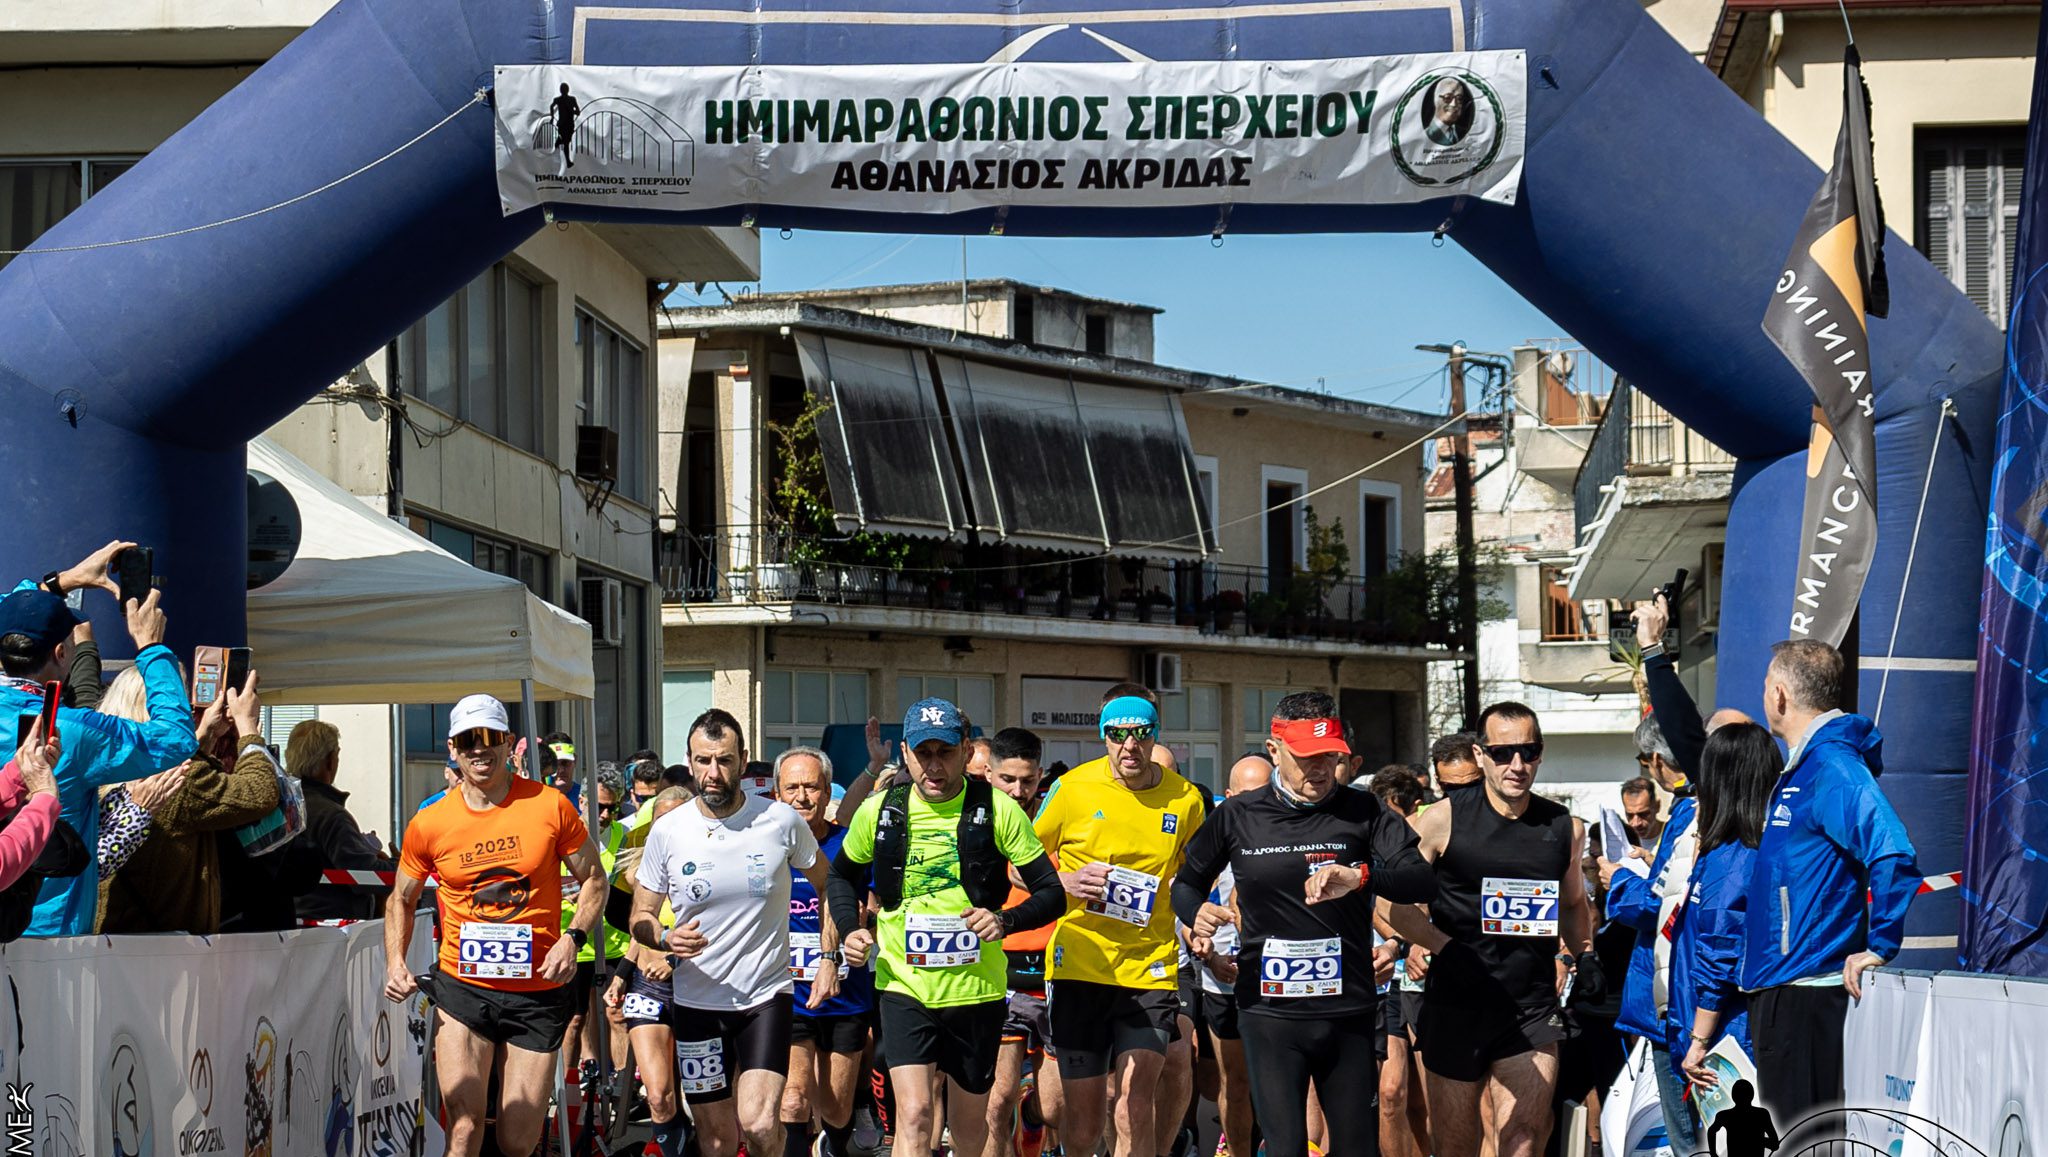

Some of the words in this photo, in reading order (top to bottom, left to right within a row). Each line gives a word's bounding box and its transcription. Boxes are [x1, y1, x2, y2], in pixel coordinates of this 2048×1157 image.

[705, 96, 1109, 144] ΗΜΙΜΑΡΑΘΩΝΙΟΣ
[1126, 90, 1378, 140] ΣΠΕΡΧΕΙΟΥ
[535, 174, 626, 185] ΗΜΙΜΑΡΑΘΩΝΙΟΣ
[631, 177, 692, 186] ΣΠΕΡΧΕΙΟΥ
[832, 158, 1065, 192] ΑΘΑΝΑΣΙΟΣ
[1078, 157, 1253, 189] ΑΚΡΙΔΑΣ
[567, 187, 618, 195] ΑΘΑΝΑΣΙΟΣ
[622, 188, 659, 196] ΑΚΡΙΔΑΣ
[920, 706, 945, 726] NY
[474, 835, 516, 856] 2023
[1103, 884, 1151, 912] 61
[1484, 896, 1556, 920] 057
[461, 940, 529, 963] 035
[908, 931, 978, 953] 070
[1265, 957, 1338, 981] 029
